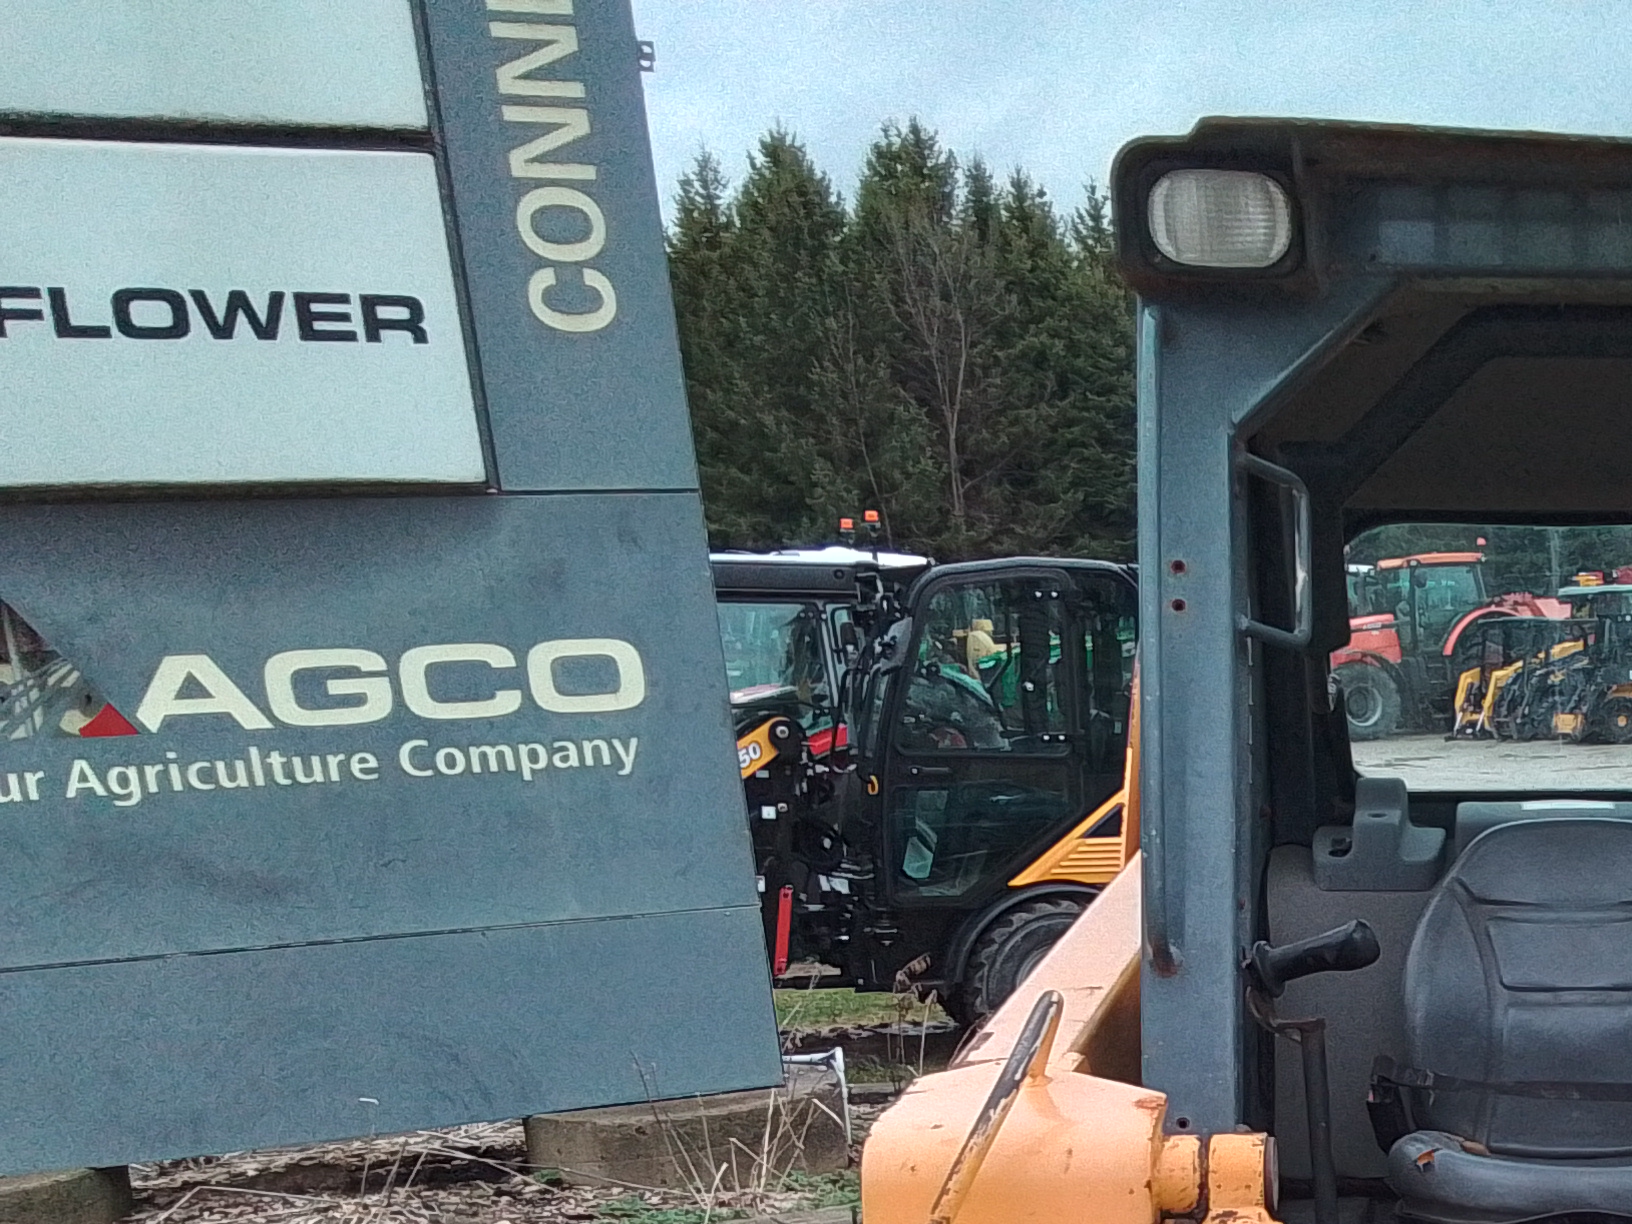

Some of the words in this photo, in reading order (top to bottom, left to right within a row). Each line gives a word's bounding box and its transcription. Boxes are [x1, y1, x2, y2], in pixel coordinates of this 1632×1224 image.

[0, 285, 429, 345] FLOWER
[136, 638, 645, 734] AGCO
[66, 748, 379, 806] Agriculture
[400, 737, 639, 781] Company
